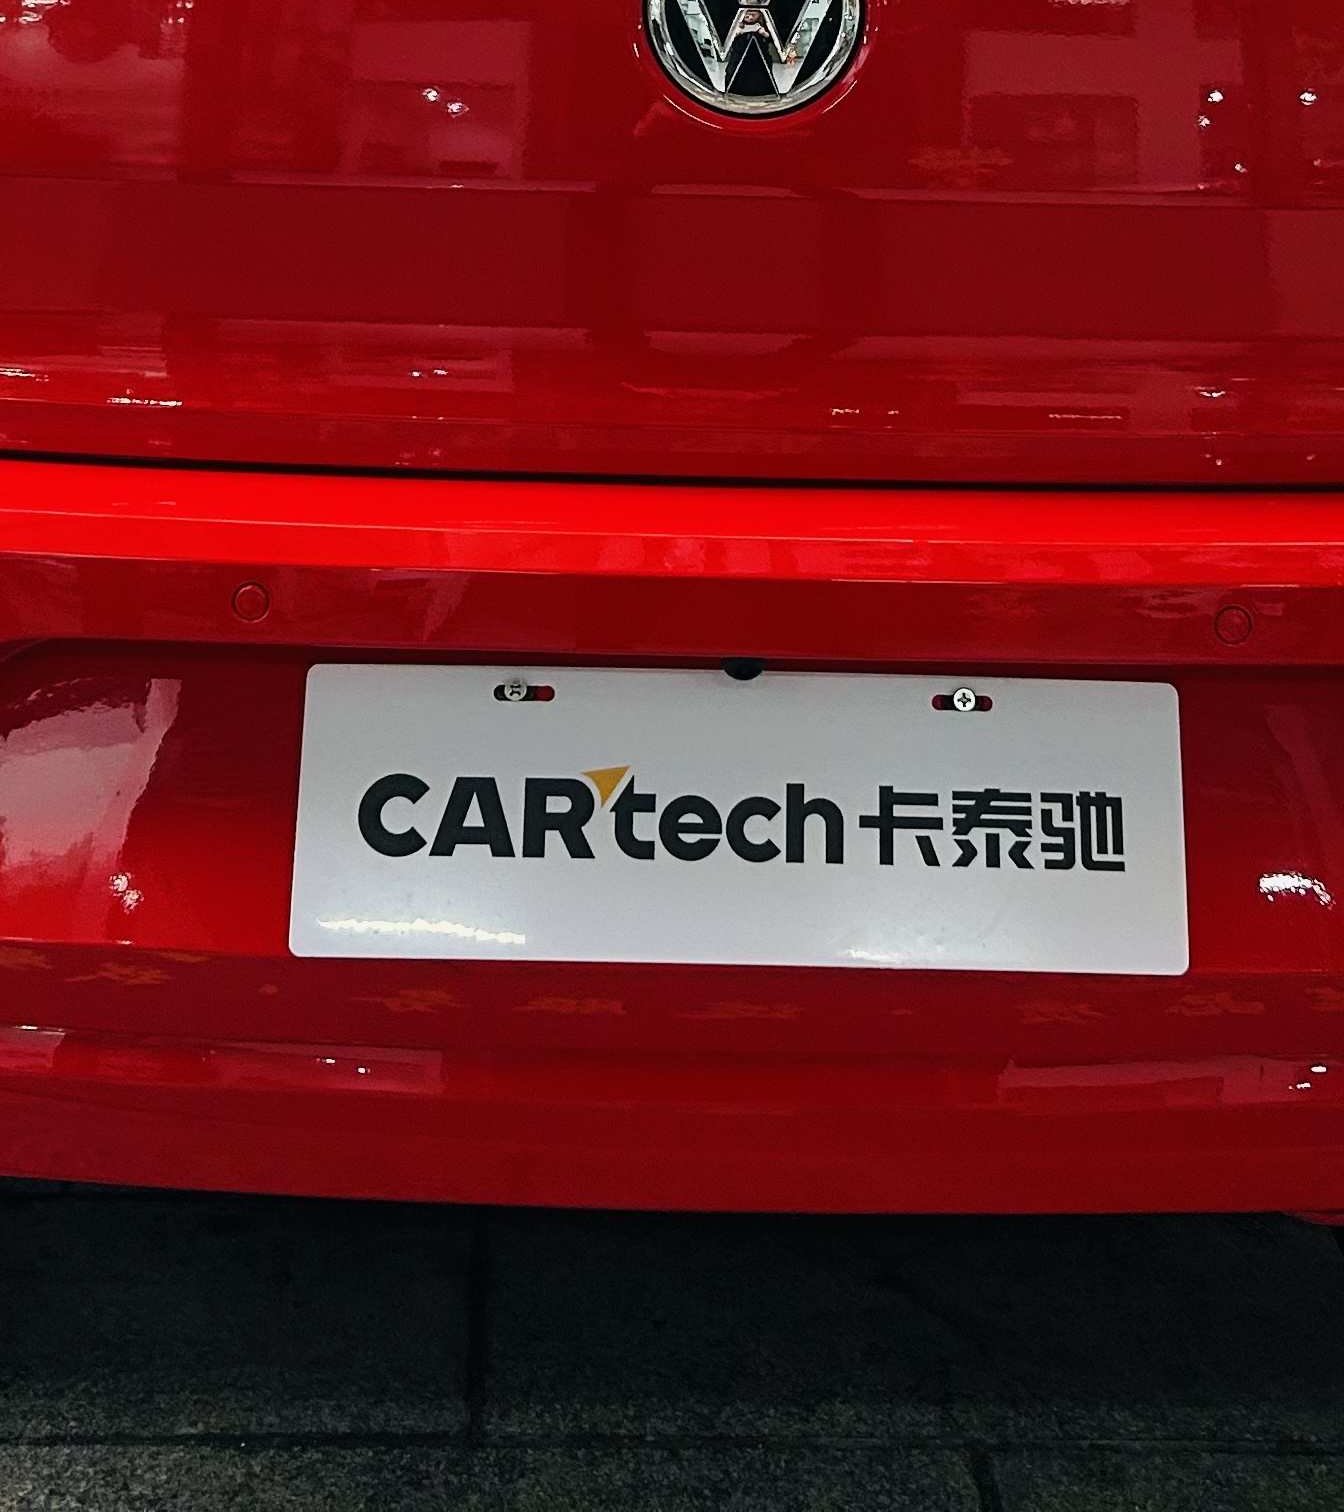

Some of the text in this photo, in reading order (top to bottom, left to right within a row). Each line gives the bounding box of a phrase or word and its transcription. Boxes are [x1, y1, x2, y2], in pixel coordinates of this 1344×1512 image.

[357, 770, 1126, 873] CARtech 卡泰驰
